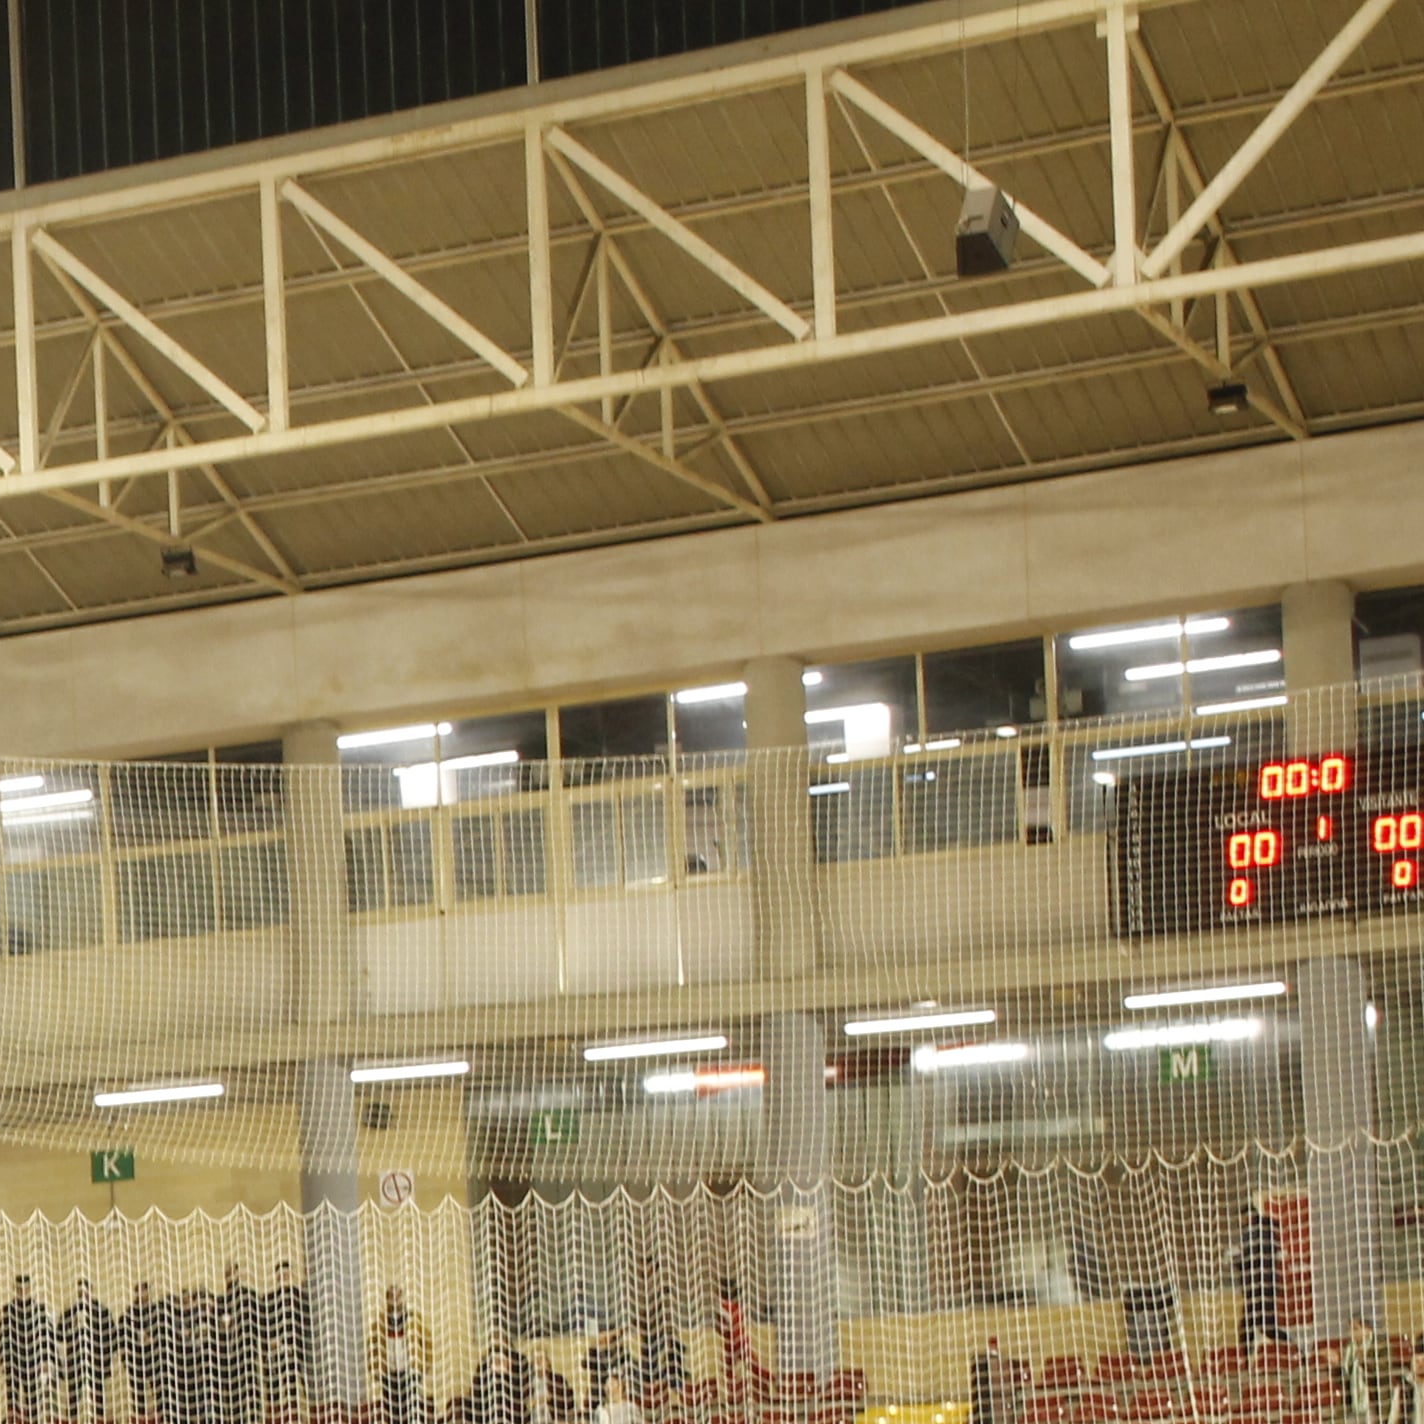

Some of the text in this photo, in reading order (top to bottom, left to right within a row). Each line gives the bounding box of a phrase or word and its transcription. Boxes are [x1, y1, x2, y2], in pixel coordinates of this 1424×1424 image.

[1260, 757, 1345, 799] 00:0
[1214, 809, 1269, 829] LOCAL
[1374, 814, 1423, 852] 00
[1229, 831, 1277, 869] 00
[1392, 860, 1412, 887] 0
[1229, 878, 1250, 906] 0
[1172, 1051, 1197, 1080] M
[101, 1152, 122, 1180] K
